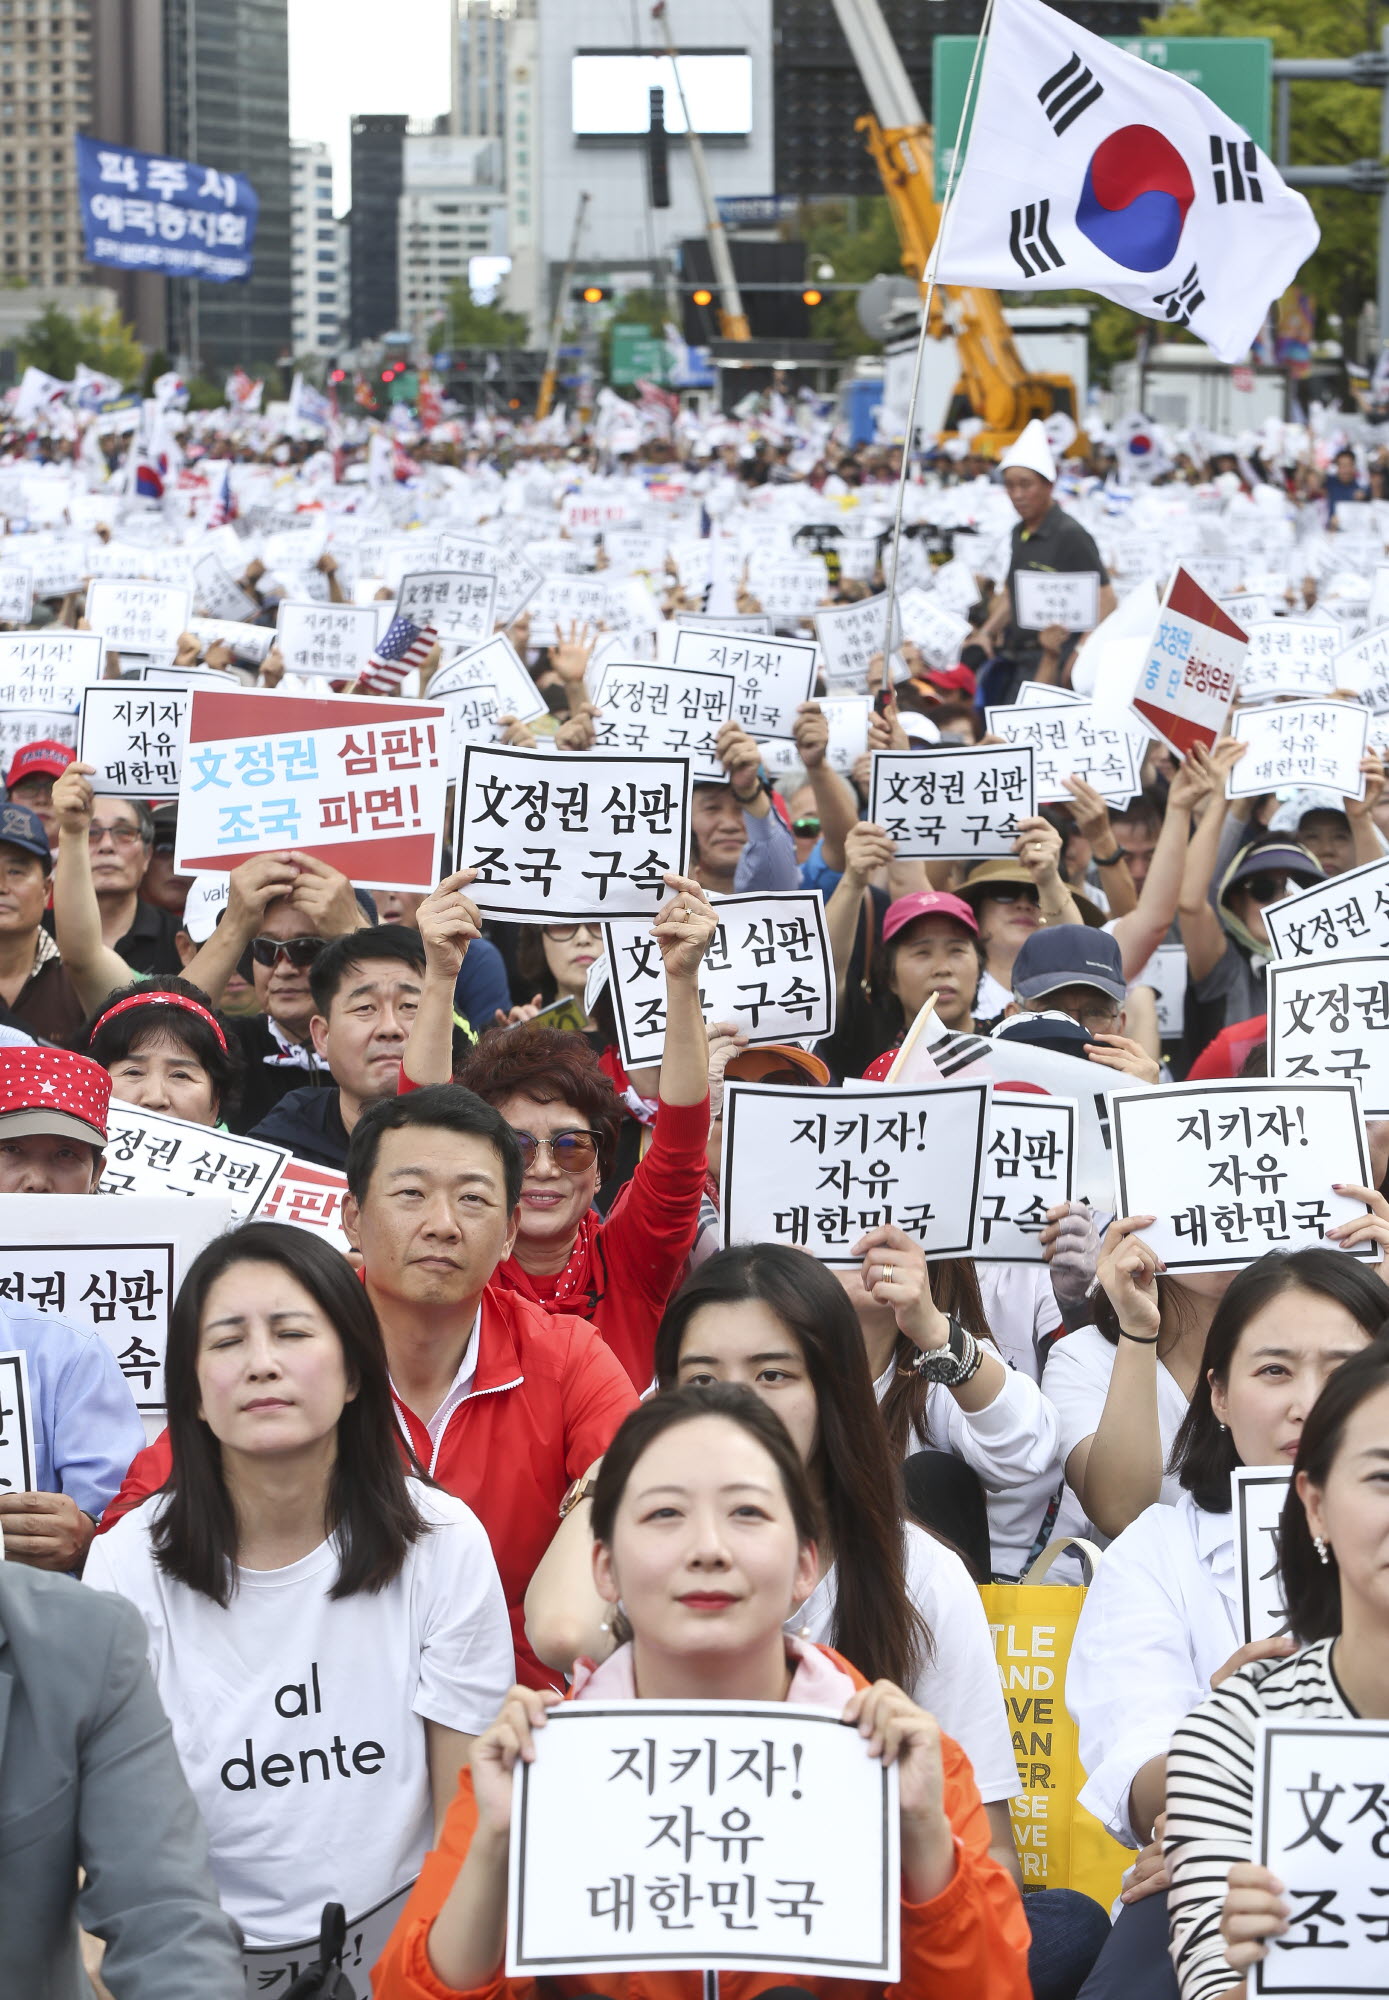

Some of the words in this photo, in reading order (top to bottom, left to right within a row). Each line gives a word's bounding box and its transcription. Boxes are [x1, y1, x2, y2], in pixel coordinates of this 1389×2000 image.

[708, 645, 783, 678] 지키자!
[1257, 631, 1292, 655] 정권
[601, 678, 670, 716] 文정권
[676, 687, 727, 723] 심판
[737, 676, 763, 701] 유
[112, 700, 188, 729] 지키자
[596, 721, 650, 753] 조국
[1268, 712, 1338, 734] 지키자!
[127, 731, 177, 758] 자유
[189, 736, 320, 793] 文정권
[336, 723, 439, 777] 심판!
[1281, 734, 1320, 754] 자유
[104, 760, 182, 787] 대한민
[882, 770, 965, 806] 文정권
[973, 765, 1028, 805] 심판
[1072, 753, 1127, 783] 구속
[1255, 756, 1340, 779] 대한민국
[216, 797, 302, 846] 조국
[318, 783, 422, 835] 파면!
[471, 773, 589, 833] 文정권
[600, 782, 679, 836] 심판
[885, 814, 947, 847] 조국
[960, 811, 1028, 847] 구속
[468, 844, 563, 899] 조국
[580, 848, 672, 902] 구속
[622, 922, 733, 984] 文권
[740, 916, 816, 968] 심판
[1282, 896, 1372, 958] 文정권
[732, 975, 822, 1029] 구속
[1281, 979, 1389, 1040] 文정권
[789, 1109, 928, 1155] 지키자!
[1176, 1104, 1309, 1151] 지키자!
[106, 1127, 182, 1173] 정권
[187, 1149, 263, 1194] 심판
[987, 1126, 1064, 1180] 심판
[1207, 1153, 1289, 1197] 자유
[815, 1158, 900, 1200] 자유
[772, 1202, 936, 1246] 대한민국
[979, 1193, 1050, 1245] 구속
[1170, 1199, 1332, 1248] 대한민국
[79, 1268, 164, 1325] 심판
[117, 1335, 162, 1391] 속
[274, 1661, 322, 1719] al
[220, 1735, 386, 1792] dente
[607, 1737, 804, 1801] 지키자!
[644, 1804, 765, 1865] 자유
[1012, 1823, 1048, 1847] VE
[1017, 1852, 1048, 1877] R!
[586, 1872, 825, 1937] 대한민국
